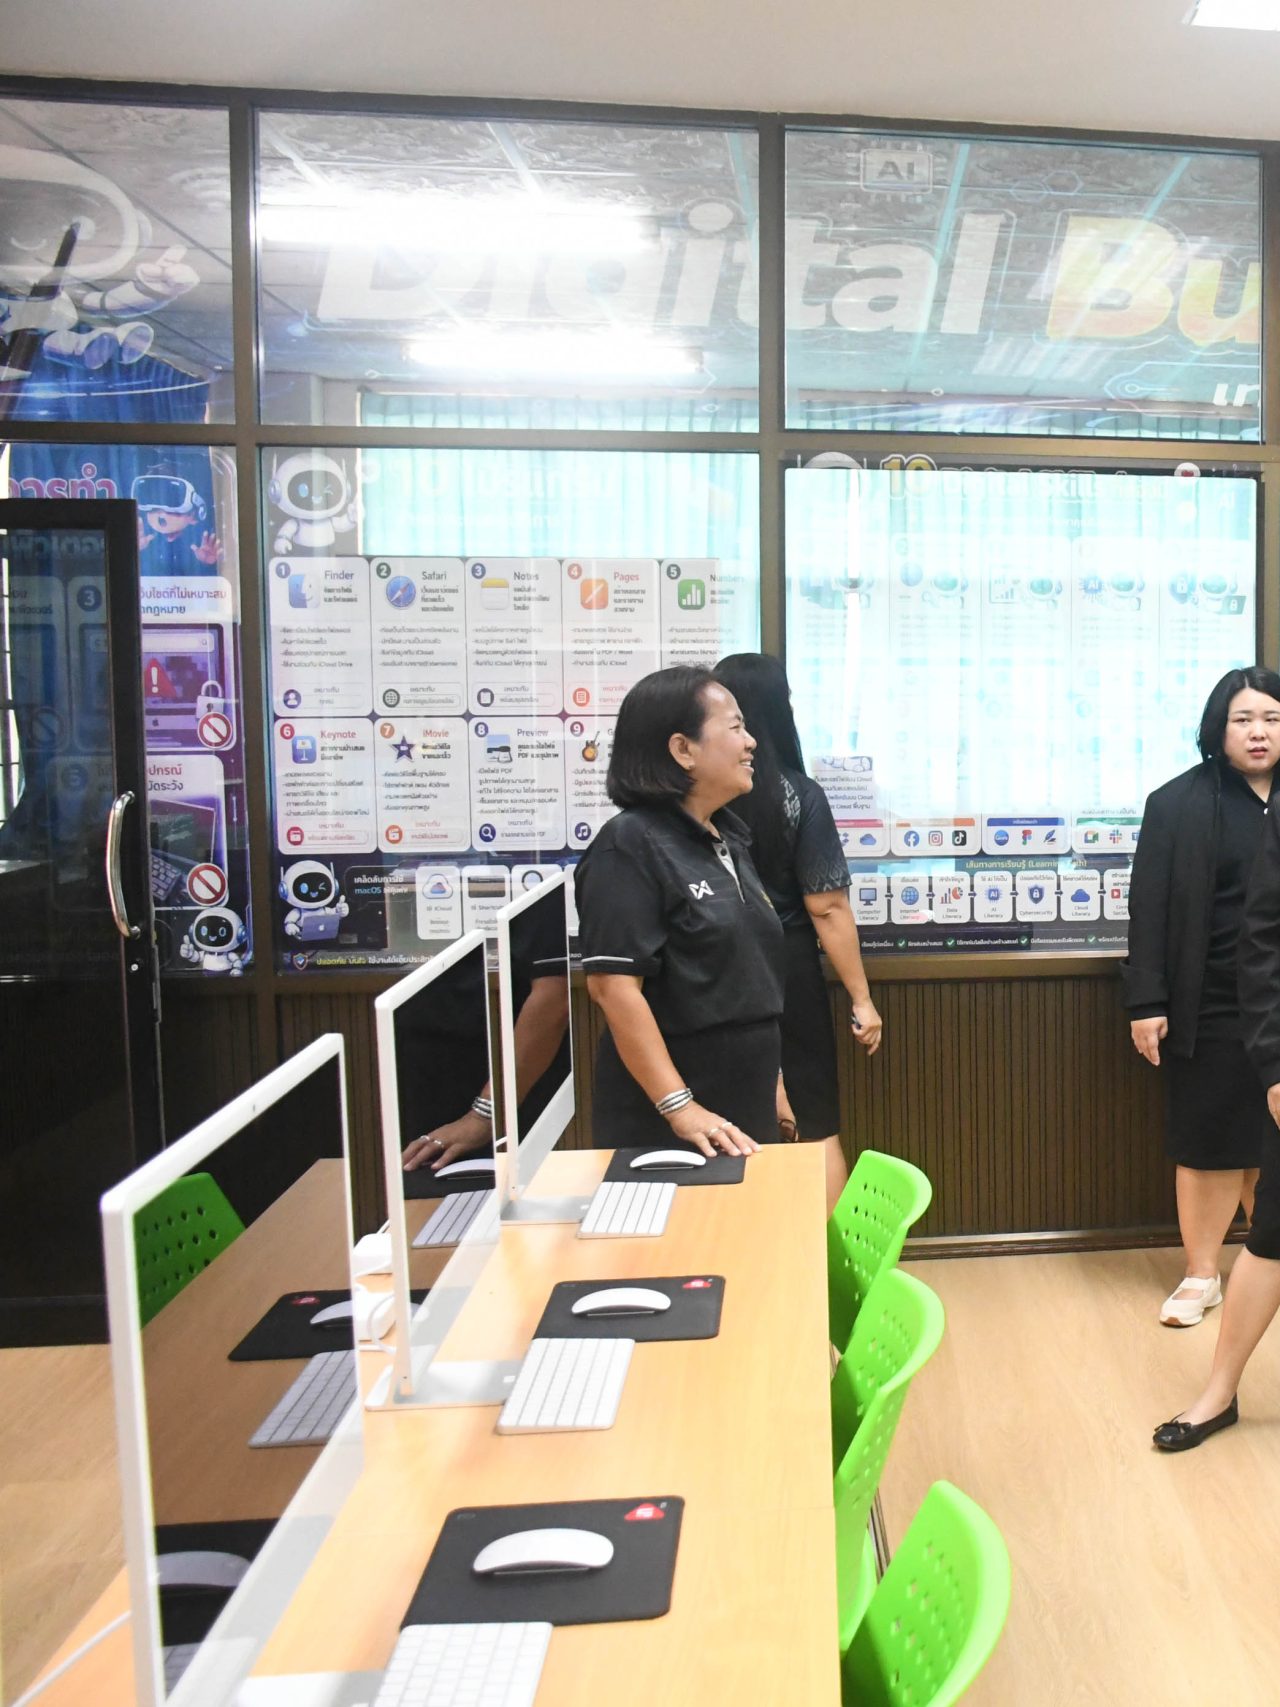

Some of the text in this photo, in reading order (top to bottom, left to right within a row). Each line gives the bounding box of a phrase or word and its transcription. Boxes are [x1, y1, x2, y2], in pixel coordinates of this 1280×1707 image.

[877, 160, 914, 181] AI
[884, 458, 934, 498] 10
[324, 570, 355, 581] Finder
[422, 571, 447, 581] Safari
[613, 572, 640, 583] Pages
[320, 730, 357, 740] Keynote
[423, 729, 449, 738] iMovie
[517, 728, 549, 737] Preview
[354, 887, 382, 895] macOS
